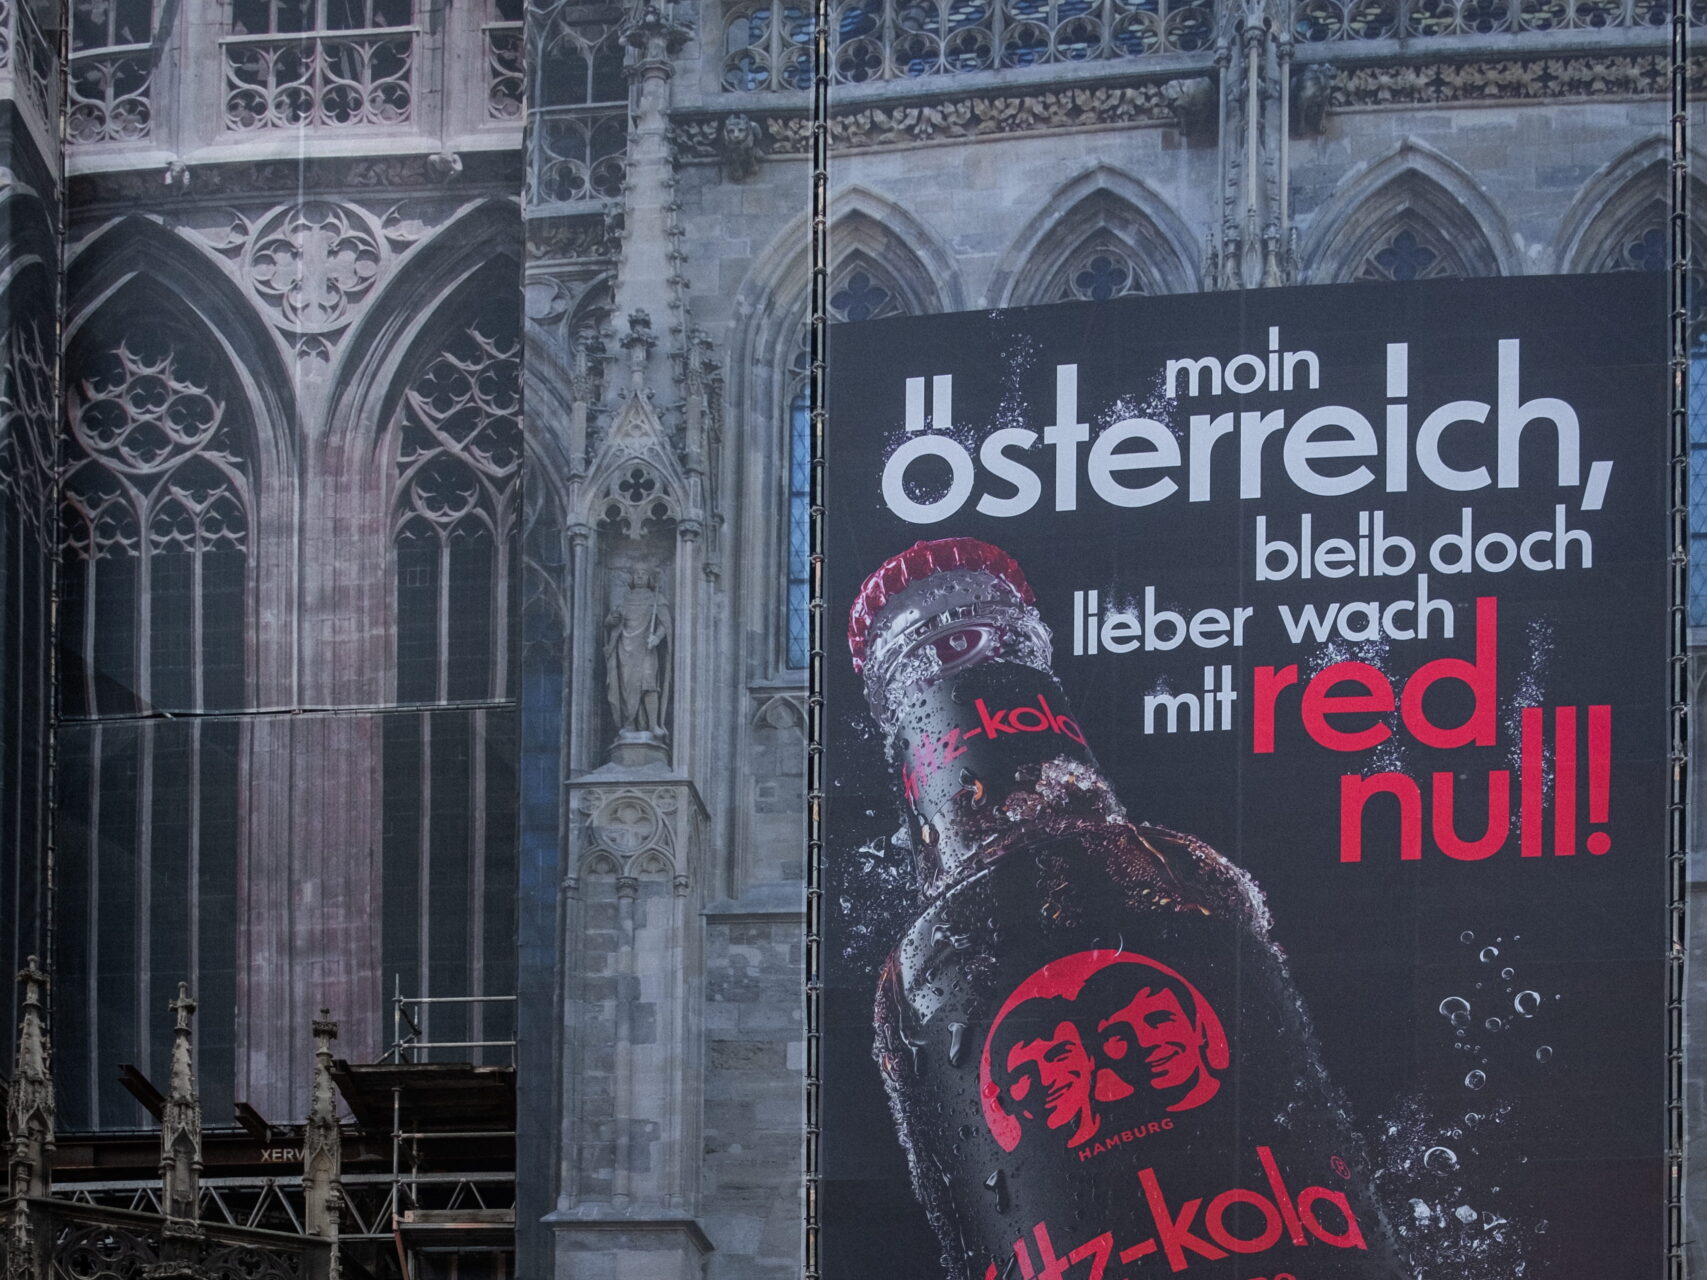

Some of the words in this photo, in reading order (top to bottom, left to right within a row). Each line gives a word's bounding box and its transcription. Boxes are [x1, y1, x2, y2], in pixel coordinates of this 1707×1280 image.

[1166, 327, 1320, 399] moin
[881, 339, 1615, 524] österreich,
[1255, 511, 1416, 581] bleib
[1429, 505, 1593, 573] doch
[1073, 586, 1253, 656] lieber
[1278, 575, 1455, 643] wach
[1143, 665, 1237, 735] mit
[1253, 597, 1497, 754] red
[1340, 705, 1613, 863] null!
[1077, 1117, 1175, 1163] HAMBURG
